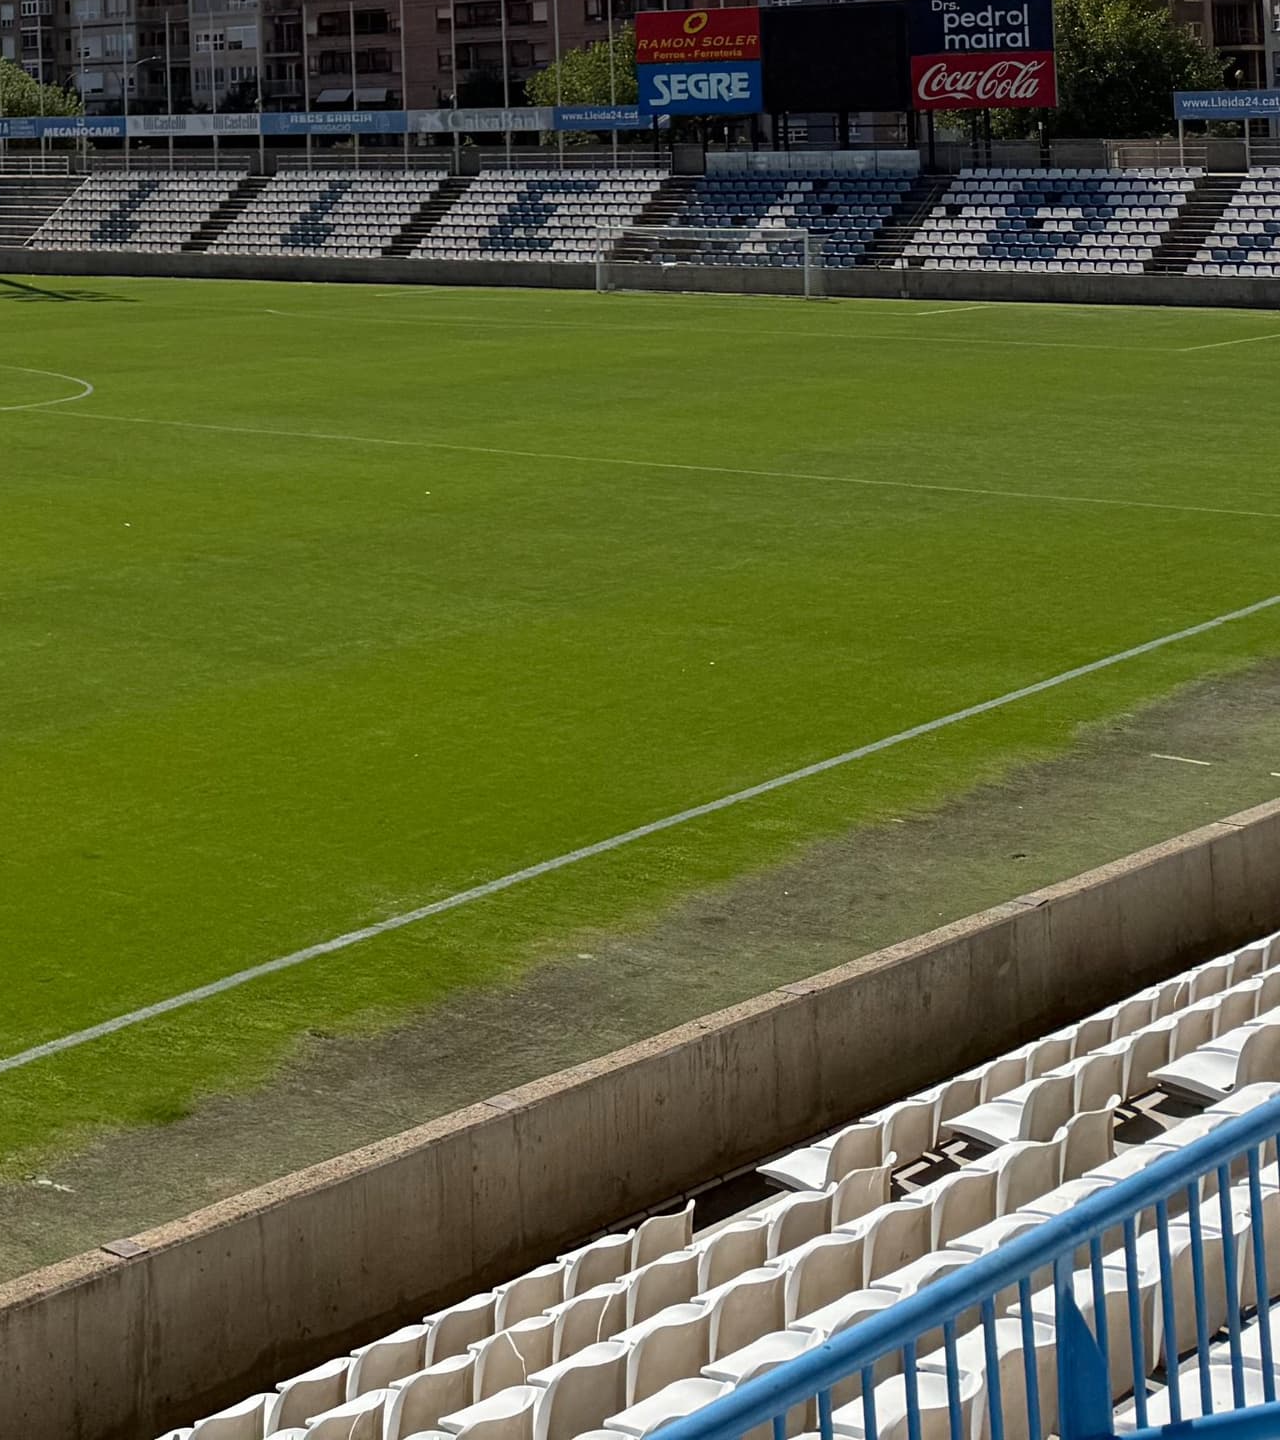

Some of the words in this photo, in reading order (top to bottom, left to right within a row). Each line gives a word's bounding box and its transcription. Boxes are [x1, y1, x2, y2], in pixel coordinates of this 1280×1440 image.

[931, 0, 960, 11] Drs.
[943, 3, 1028, 33] pedrol
[637, 37, 696, 49] RAMON
[702, 35, 758, 47] SOLER
[944, 25, 1030, 50] mairal
[653, 51, 685, 59] Ferros
[694, 49, 742, 58] Ferreteria
[918, 60, 1046, 101] Coca-Cola
[648, 72, 751, 106] SEGRE
[1182, 96, 1279, 107] www.Lleida24.cat
[561, 110, 639, 120] www.Lleida24.cat
